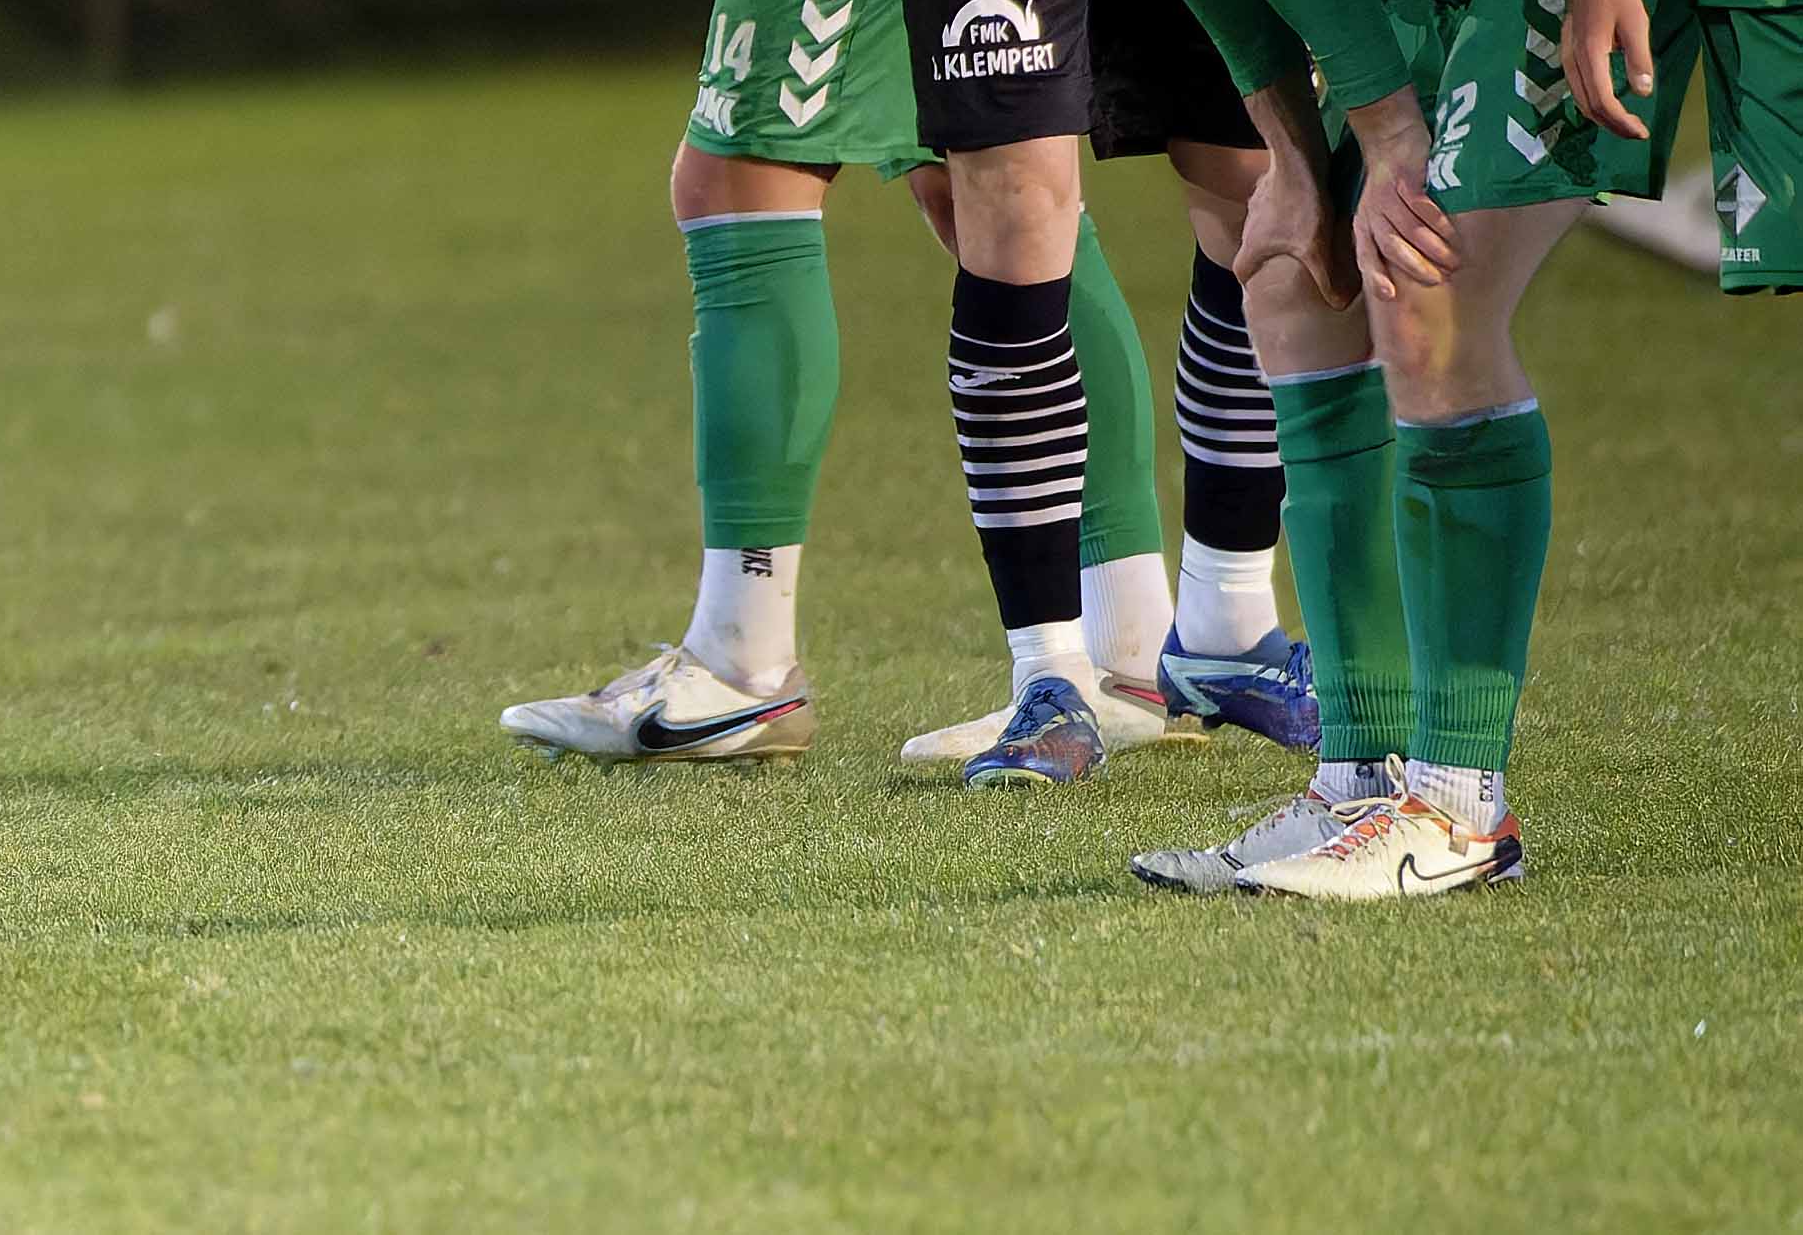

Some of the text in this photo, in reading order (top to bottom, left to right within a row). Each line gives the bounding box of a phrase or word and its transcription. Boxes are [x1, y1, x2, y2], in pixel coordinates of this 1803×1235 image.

[708, 13, 757, 82] 14
[970, 20, 1009, 45] FMK
[944, 42, 1054, 81] KLEMPERT
